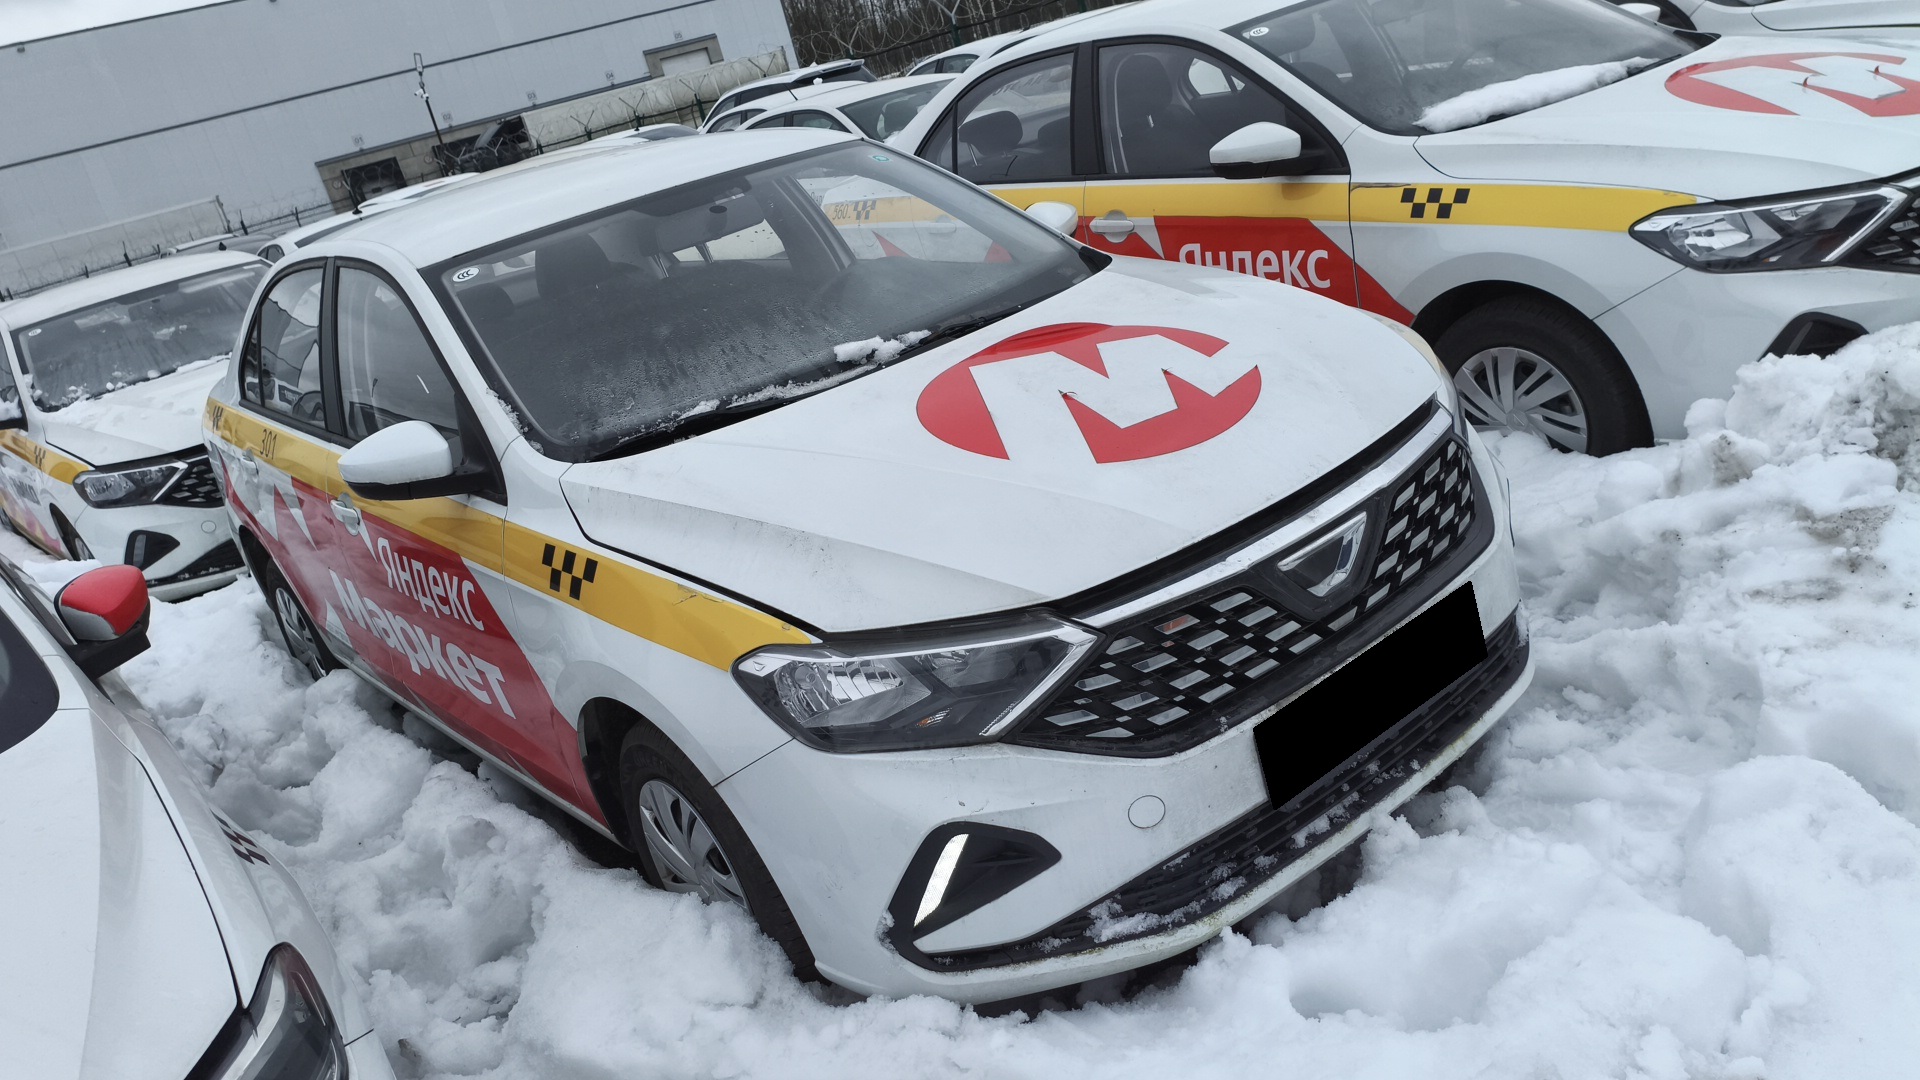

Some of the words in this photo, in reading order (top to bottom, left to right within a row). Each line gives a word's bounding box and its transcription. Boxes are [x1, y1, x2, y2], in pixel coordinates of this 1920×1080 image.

[260, 428, 277, 460] 301
[377, 537, 485, 631] Яндекс
[328, 568, 517, 720] Маркет
